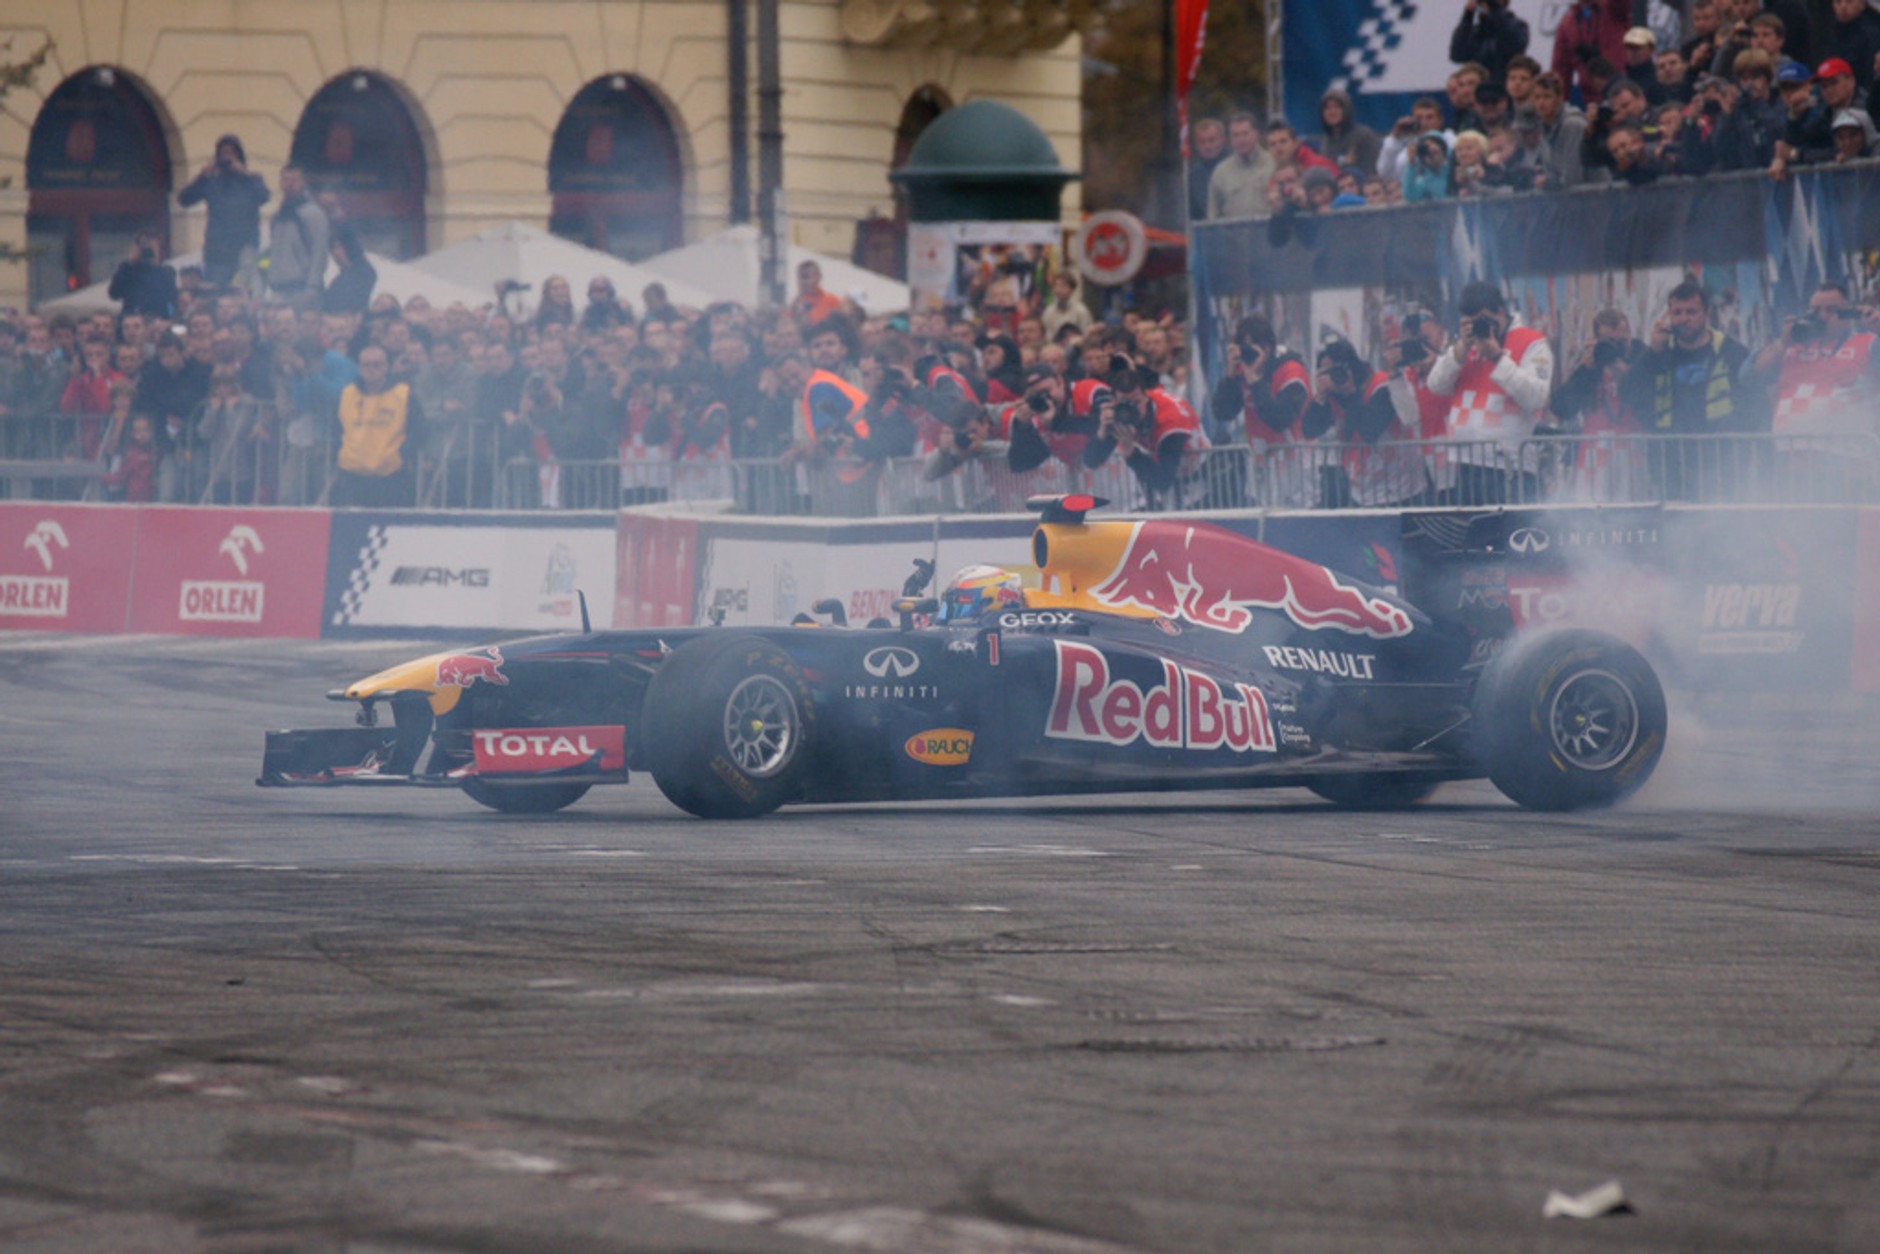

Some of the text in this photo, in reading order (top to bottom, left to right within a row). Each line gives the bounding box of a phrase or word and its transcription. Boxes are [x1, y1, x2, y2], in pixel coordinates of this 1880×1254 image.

[419, 567, 490, 587] AMG
[185, 586, 259, 615] ORLEN
[1703, 583, 1801, 628] verva
[1000, 612, 1075, 628] GEOX
[987, 633, 999, 666] 1
[1262, 645, 1376, 680] RENAULT
[845, 685, 938, 699] INFINITI
[1045, 639, 1277, 752] Red Bull
[475, 732, 597, 757] TOTAL
